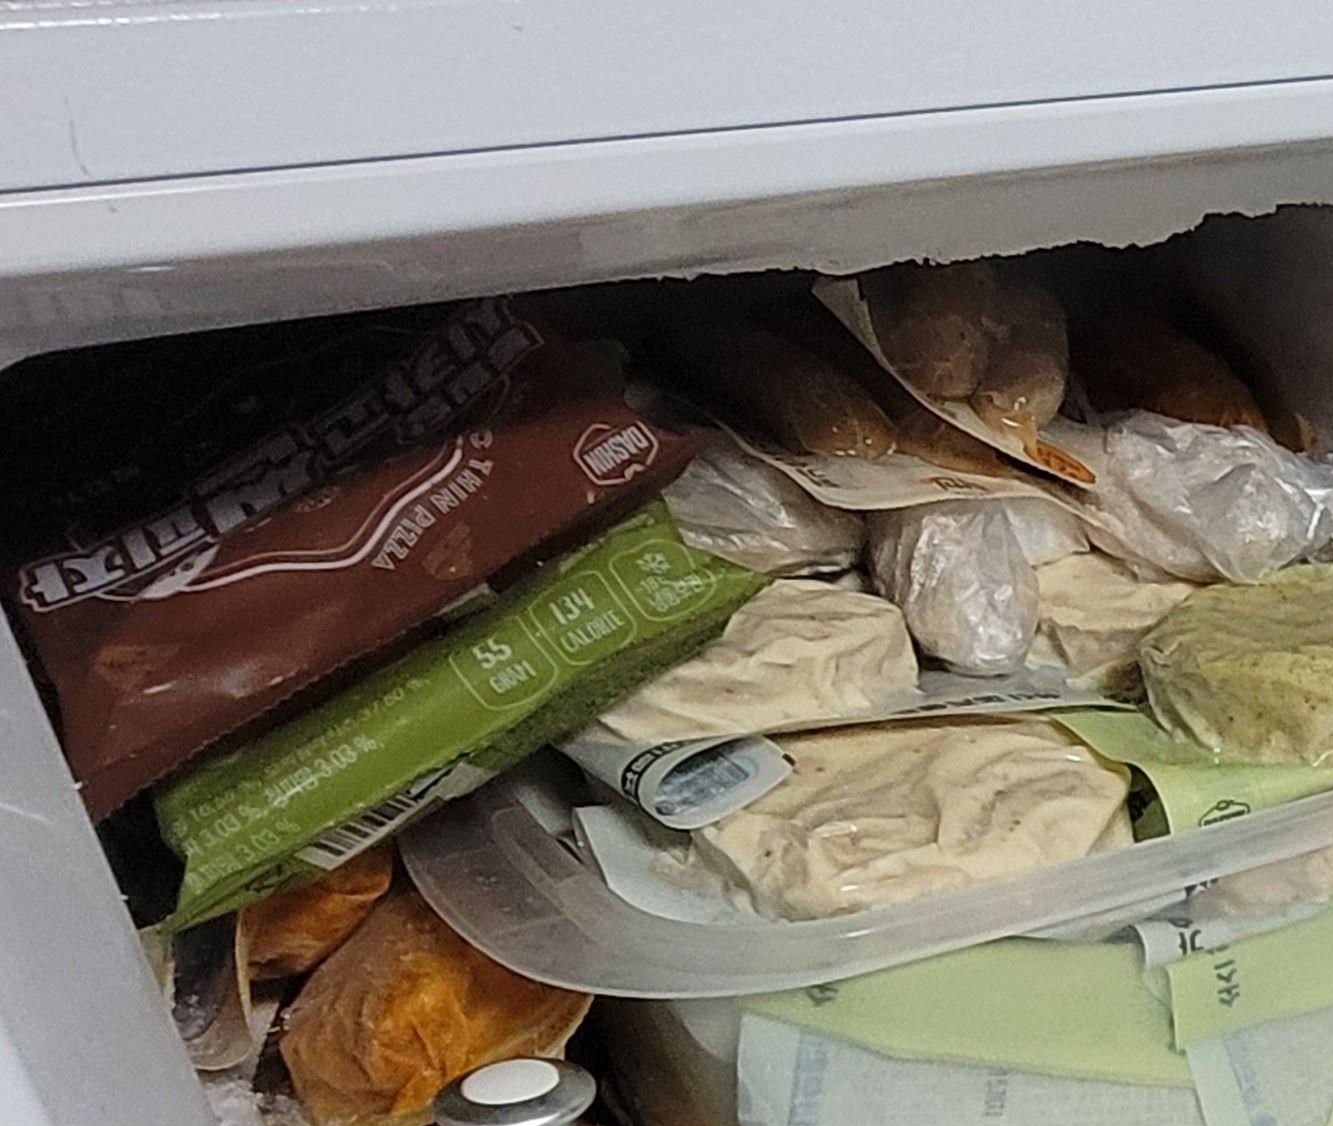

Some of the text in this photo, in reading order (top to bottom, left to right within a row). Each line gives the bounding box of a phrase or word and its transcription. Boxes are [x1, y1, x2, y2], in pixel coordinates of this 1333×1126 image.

[582, 425, 650, 477] DASHIN
[371, 459, 494, 571] THIN PIZZA
[548, 588, 596, 626] 134
[559, 609, 626, 654] CALORIE
[472, 638, 512, 669] 55
[488, 660, 538, 695] GRAM
